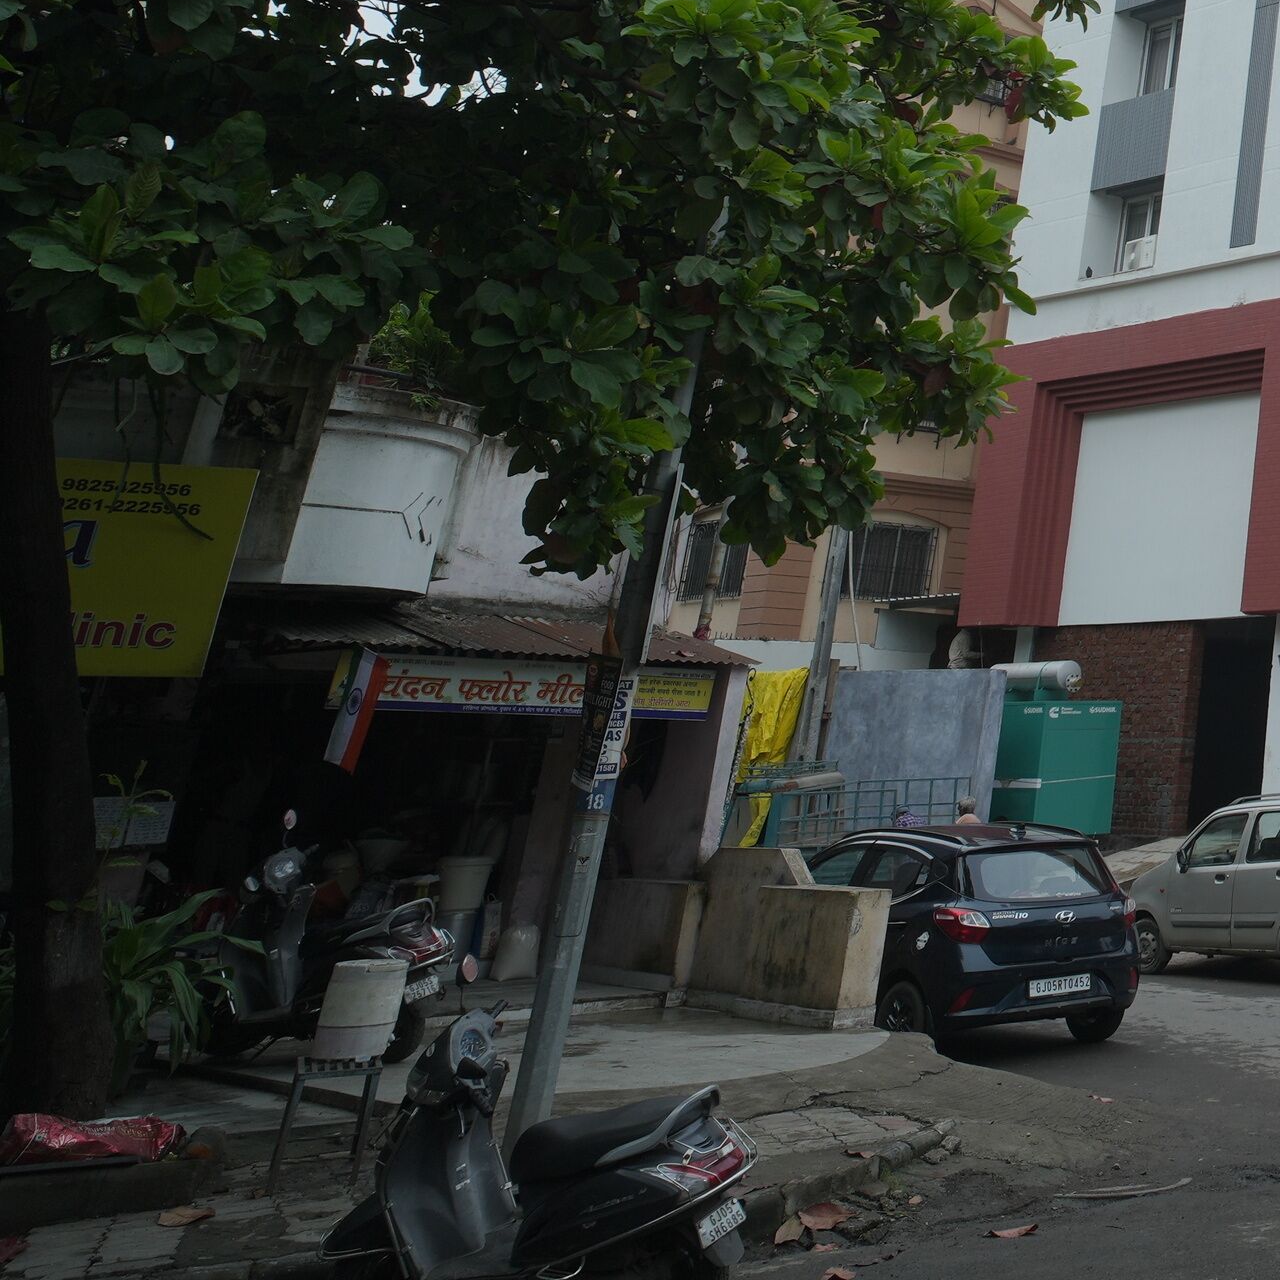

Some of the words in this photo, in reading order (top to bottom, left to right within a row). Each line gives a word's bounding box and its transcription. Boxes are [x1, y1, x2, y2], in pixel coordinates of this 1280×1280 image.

[62, 478, 192, 496] 9825425956
[1036, 976, 1090, 994] GJ05RT0452
[709, 1203, 733, 1226] GJ05
[709, 1210, 745, 1242] SH6885
